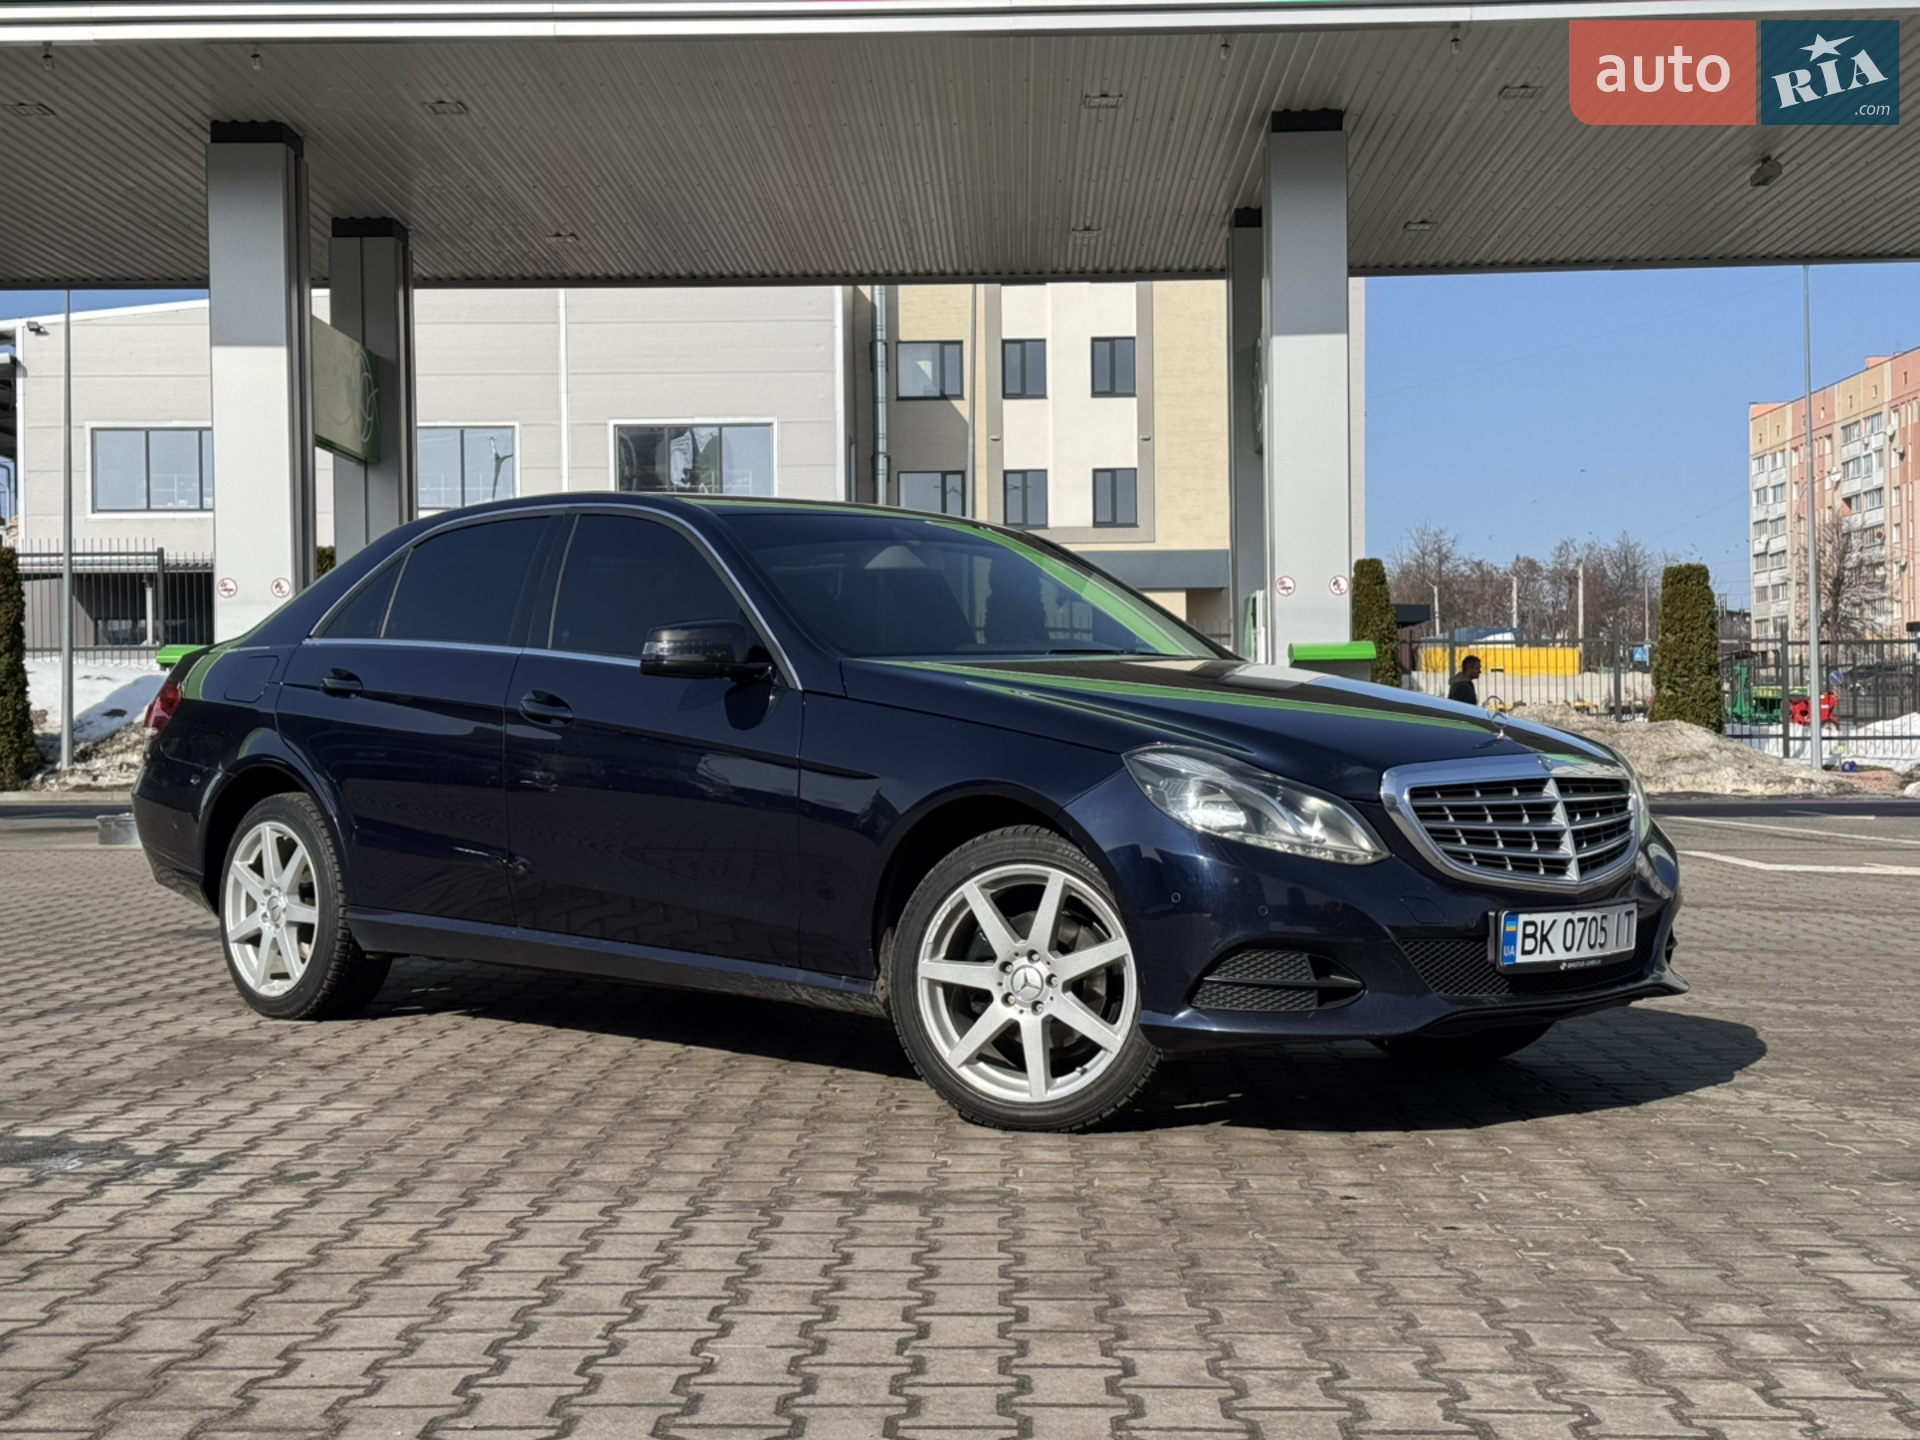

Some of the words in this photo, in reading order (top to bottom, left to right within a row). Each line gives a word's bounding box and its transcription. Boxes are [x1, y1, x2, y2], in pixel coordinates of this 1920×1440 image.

[1520, 918, 1557, 956] BK
[1562, 914, 1608, 953] 0705
[1614, 910, 1635, 948] IT
[1503, 945, 1515, 957] UA
